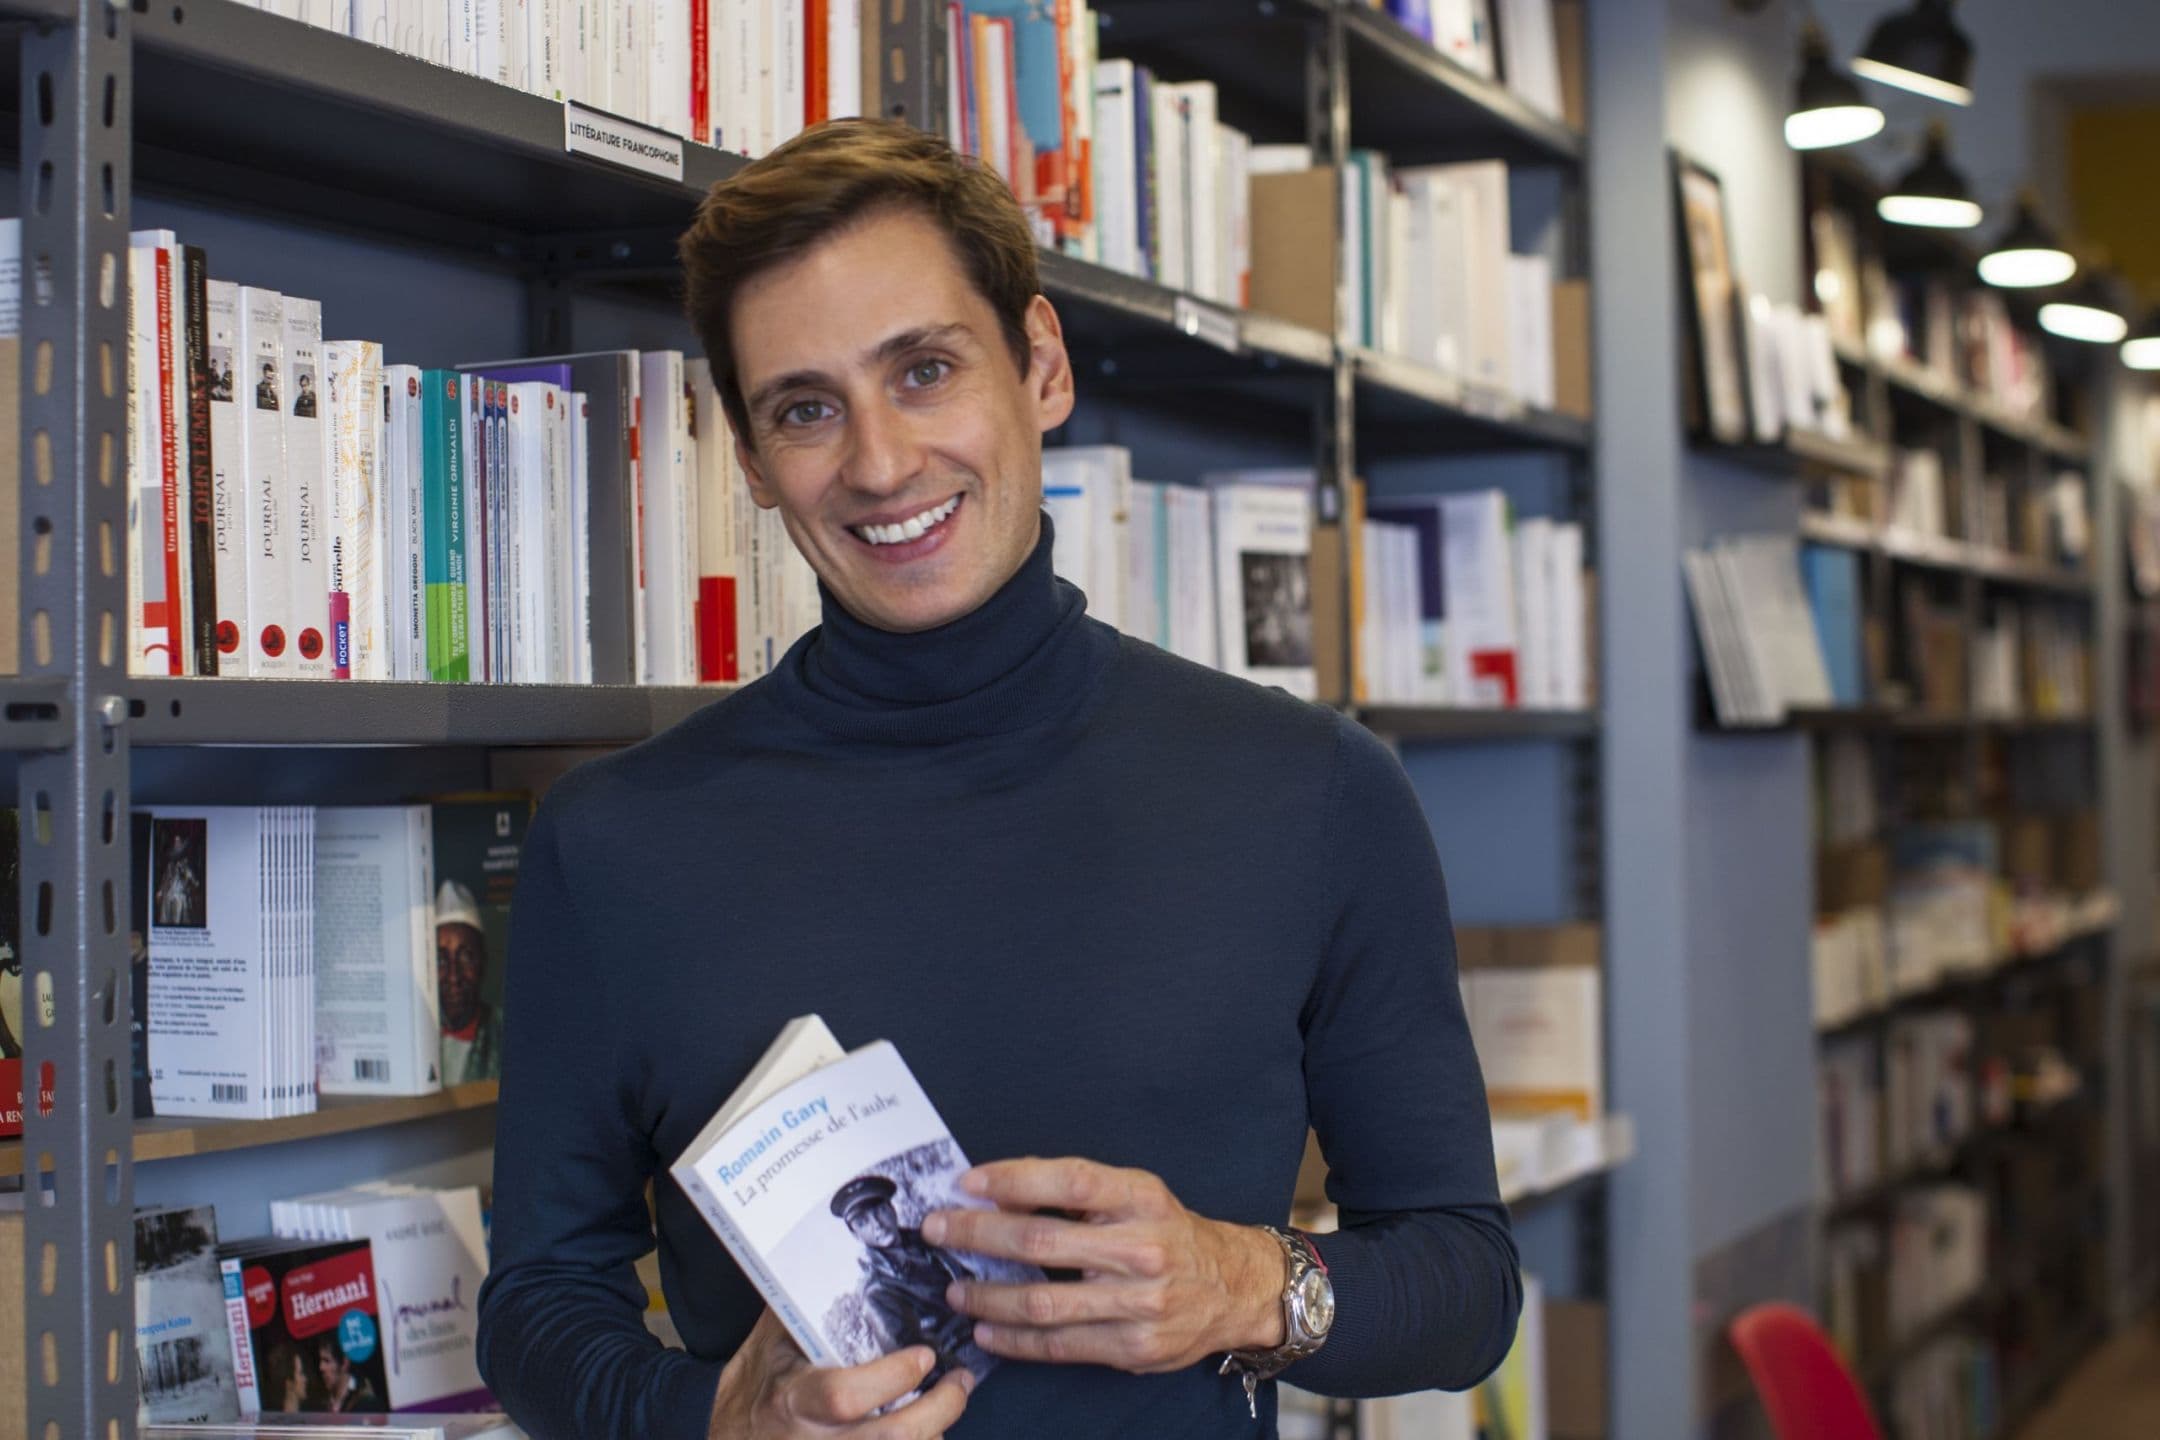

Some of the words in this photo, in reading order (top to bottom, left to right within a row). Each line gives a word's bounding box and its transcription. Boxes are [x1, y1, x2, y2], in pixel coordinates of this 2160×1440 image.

[569, 122, 621, 149] LITTÉRATURE
[622, 138, 680, 166] FRANCOPHONE
[158, 264, 169, 324] Guillaud
[160, 326, 170, 371] Maëlle
[161, 384, 173, 444] française
[163, 448, 174, 473] très
[449, 418, 458, 482] GRIMALDI
[165, 476, 176, 523] famille
[194, 465, 211, 523] JOHN
[216, 468, 228, 553] JOURNAL
[263, 475, 275, 559] JOURNAL
[300, 481, 312, 564] JOURNAL
[166, 527, 177, 553] Une
[335, 535, 343, 593] ounelle
[717, 1126, 783, 1186] Romain
[781, 1096, 830, 1130] Gary
[733, 1184, 757, 1207] La
[756, 1127, 824, 1195] promesse
[827, 1116, 848, 1134] de
[849, 1093, 899, 1122] l'aube
[291, 1272, 369, 1321] Hernani
[225, 1302, 253, 1388] Hernani
